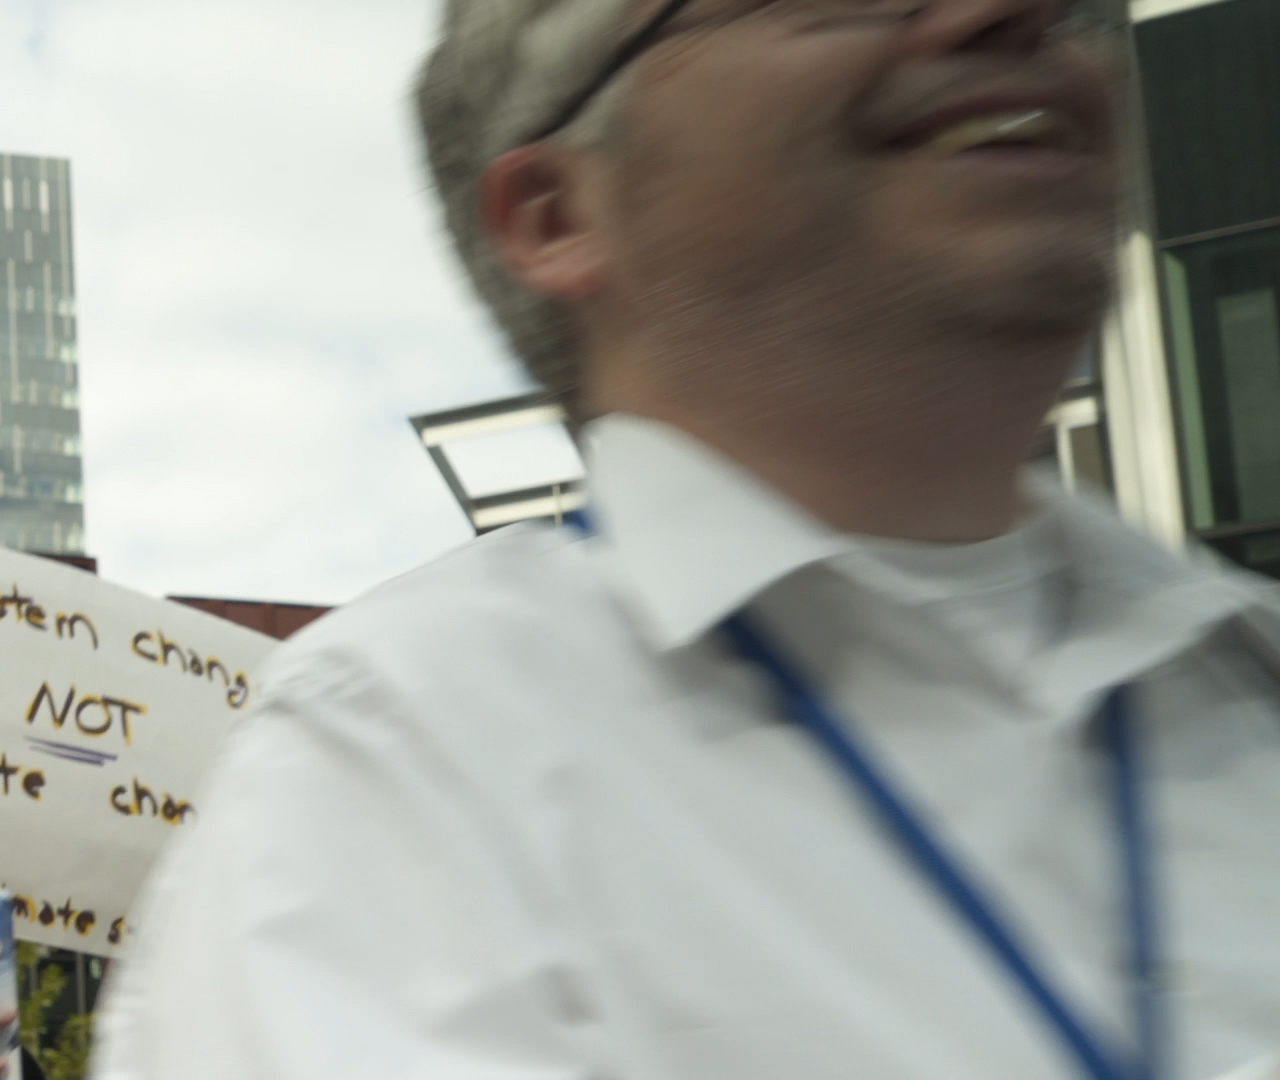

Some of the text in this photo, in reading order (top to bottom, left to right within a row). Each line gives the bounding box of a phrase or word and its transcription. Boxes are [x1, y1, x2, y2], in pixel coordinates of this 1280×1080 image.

[131, 628, 250, 711] chang
[25, 681, 148, 746] NOT
[110, 775, 198, 827] chan
